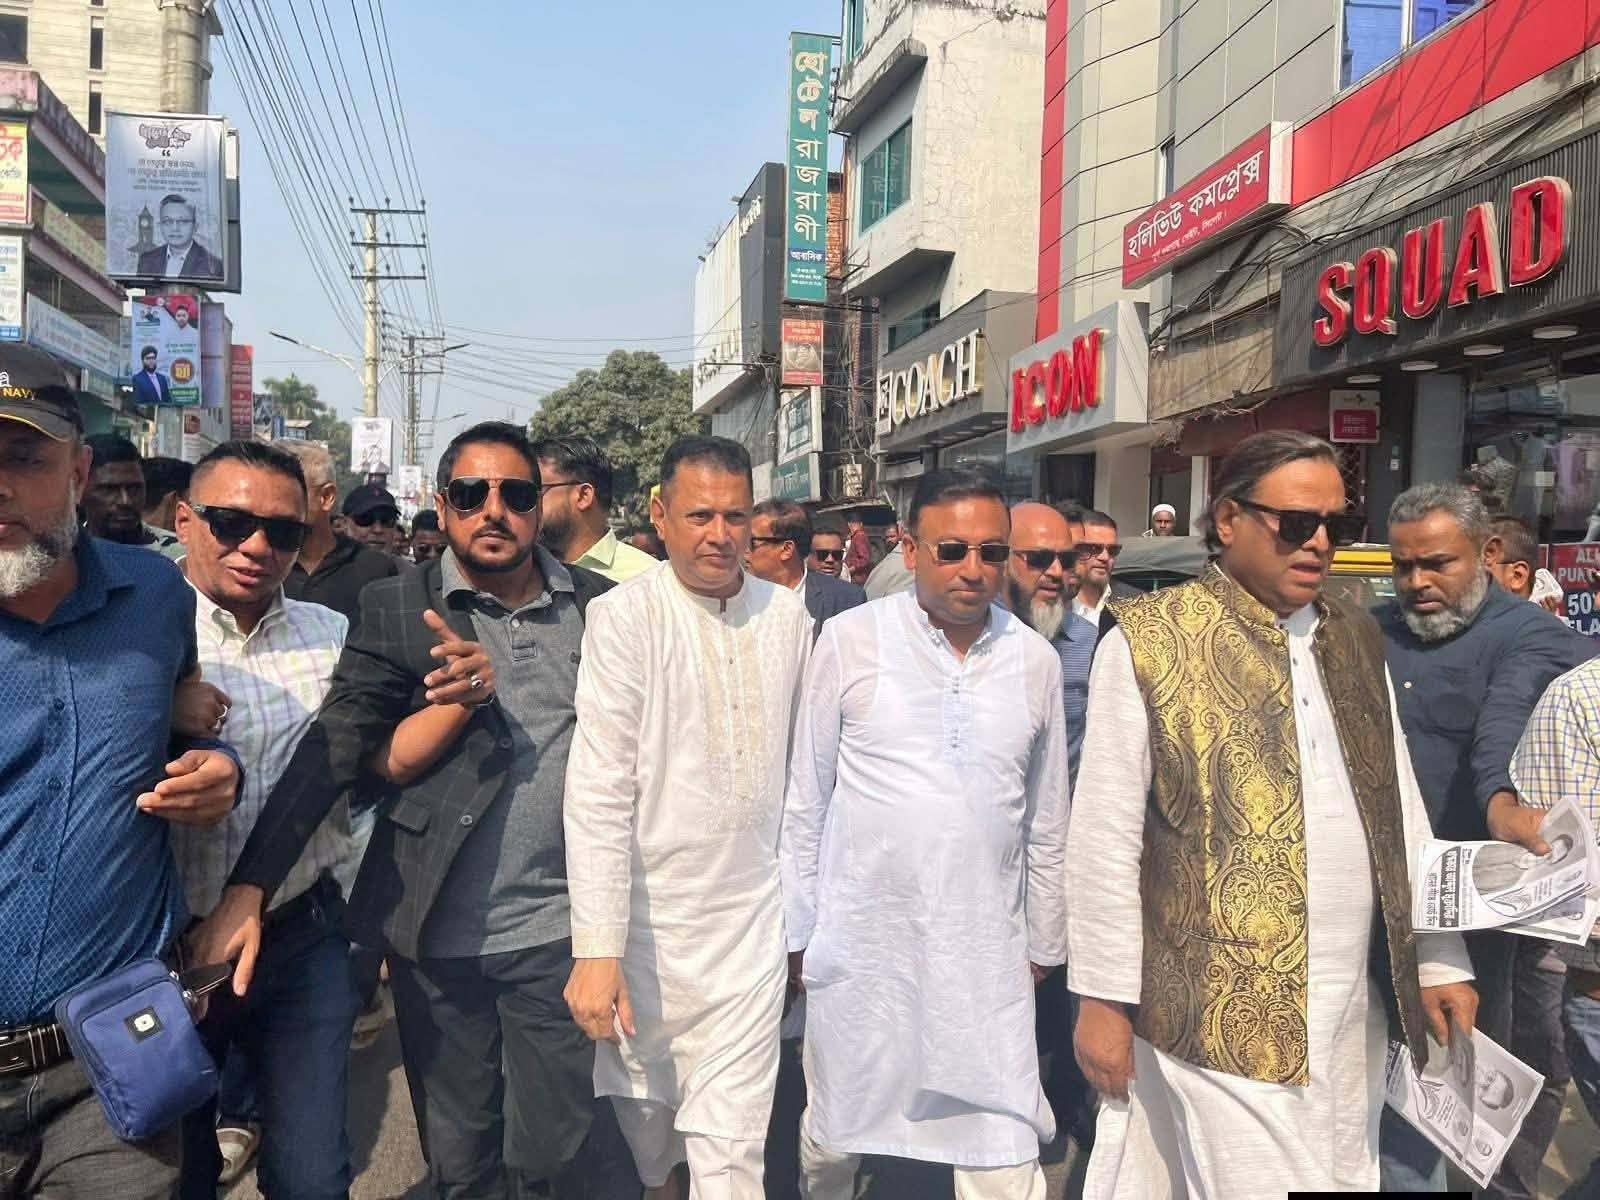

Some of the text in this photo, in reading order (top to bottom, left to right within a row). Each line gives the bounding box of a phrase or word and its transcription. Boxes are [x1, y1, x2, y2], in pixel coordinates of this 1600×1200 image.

[795, 51, 827, 131] হোটেল
[1127, 150, 1264, 258] হলিভিউ কমপ্লেক্স
[1312, 175, 1573, 348] SQUAD
[892, 328, 984, 425] COACH
[1010, 327, 1106, 433] ICON
